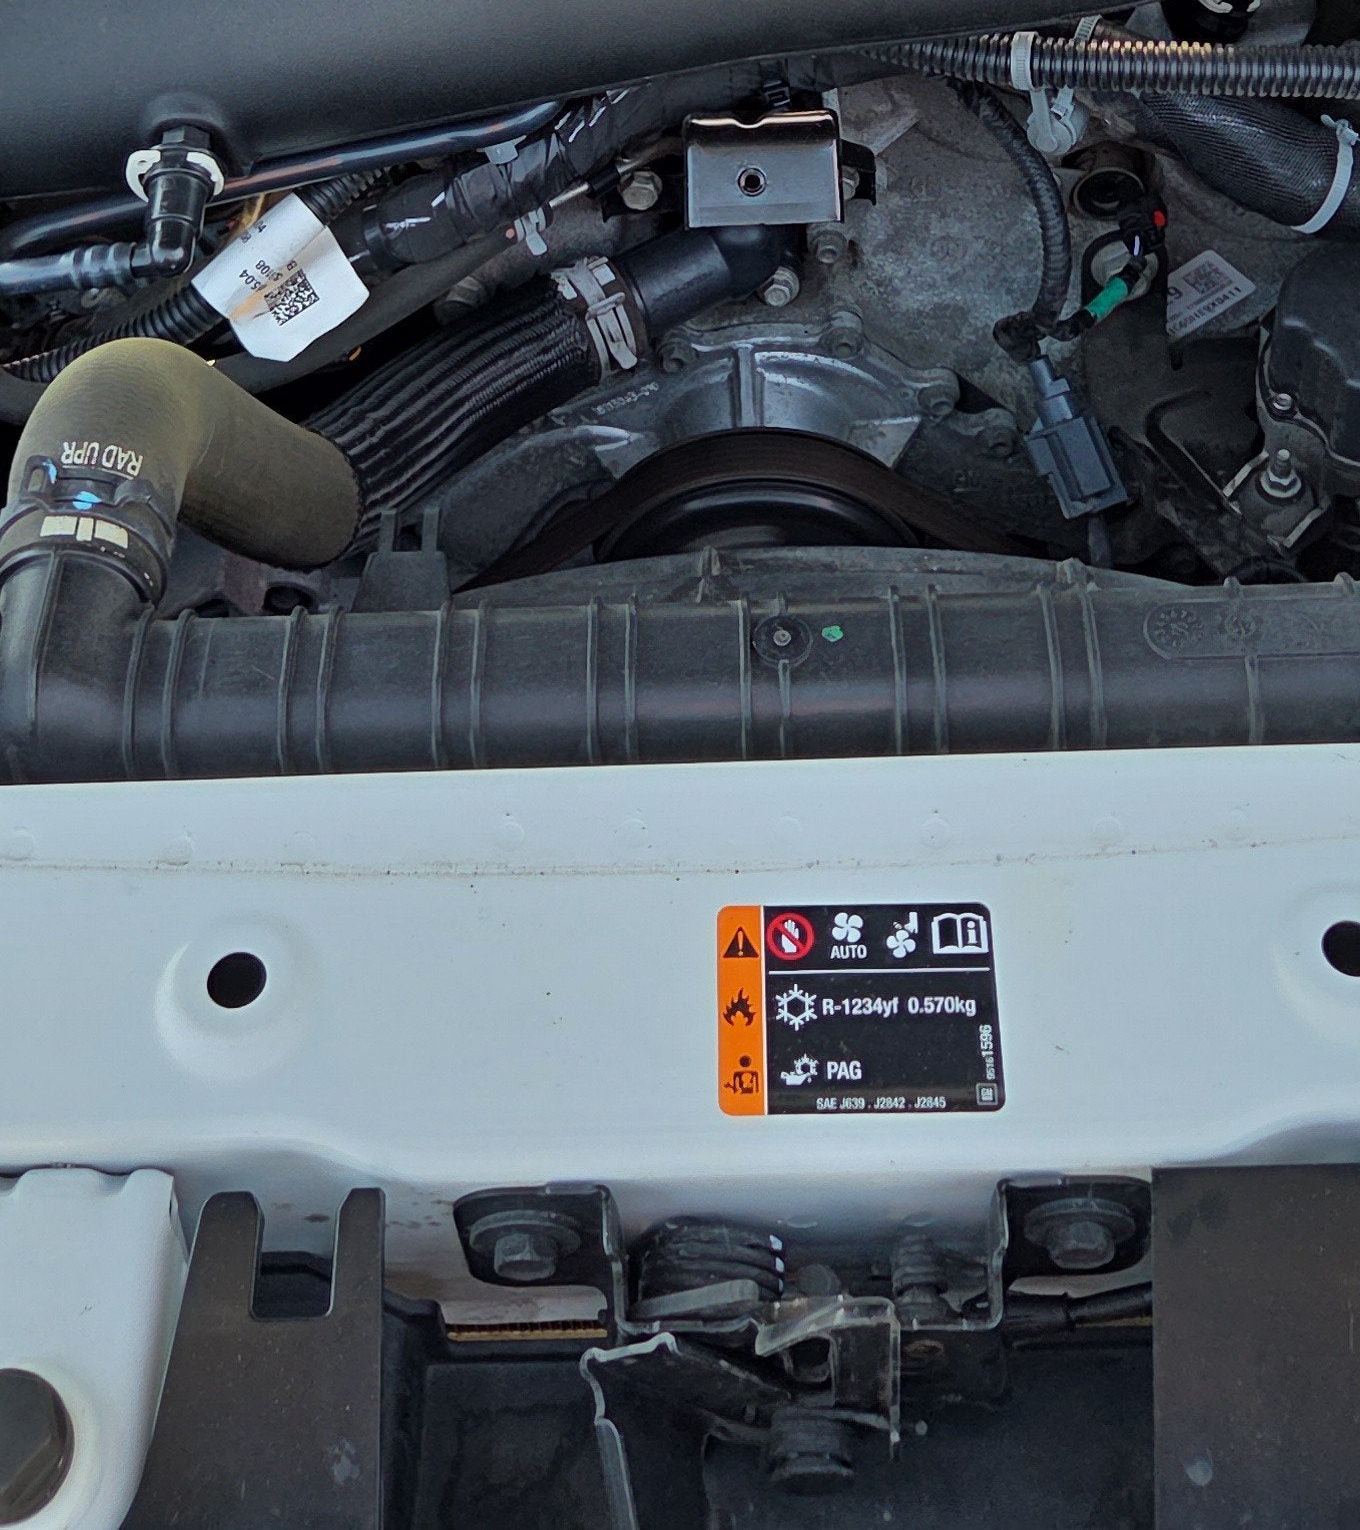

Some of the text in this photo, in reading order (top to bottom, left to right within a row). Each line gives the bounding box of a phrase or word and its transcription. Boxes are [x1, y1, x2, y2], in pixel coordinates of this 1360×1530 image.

[60, 440, 144, 478] RAD UPR
[830, 944, 868, 960] AUTO
[821, 996, 977, 1018] R-1234yf 0.570kg
[826, 1060, 863, 1080] PAG
[816, 1097, 838, 1110] SAE
